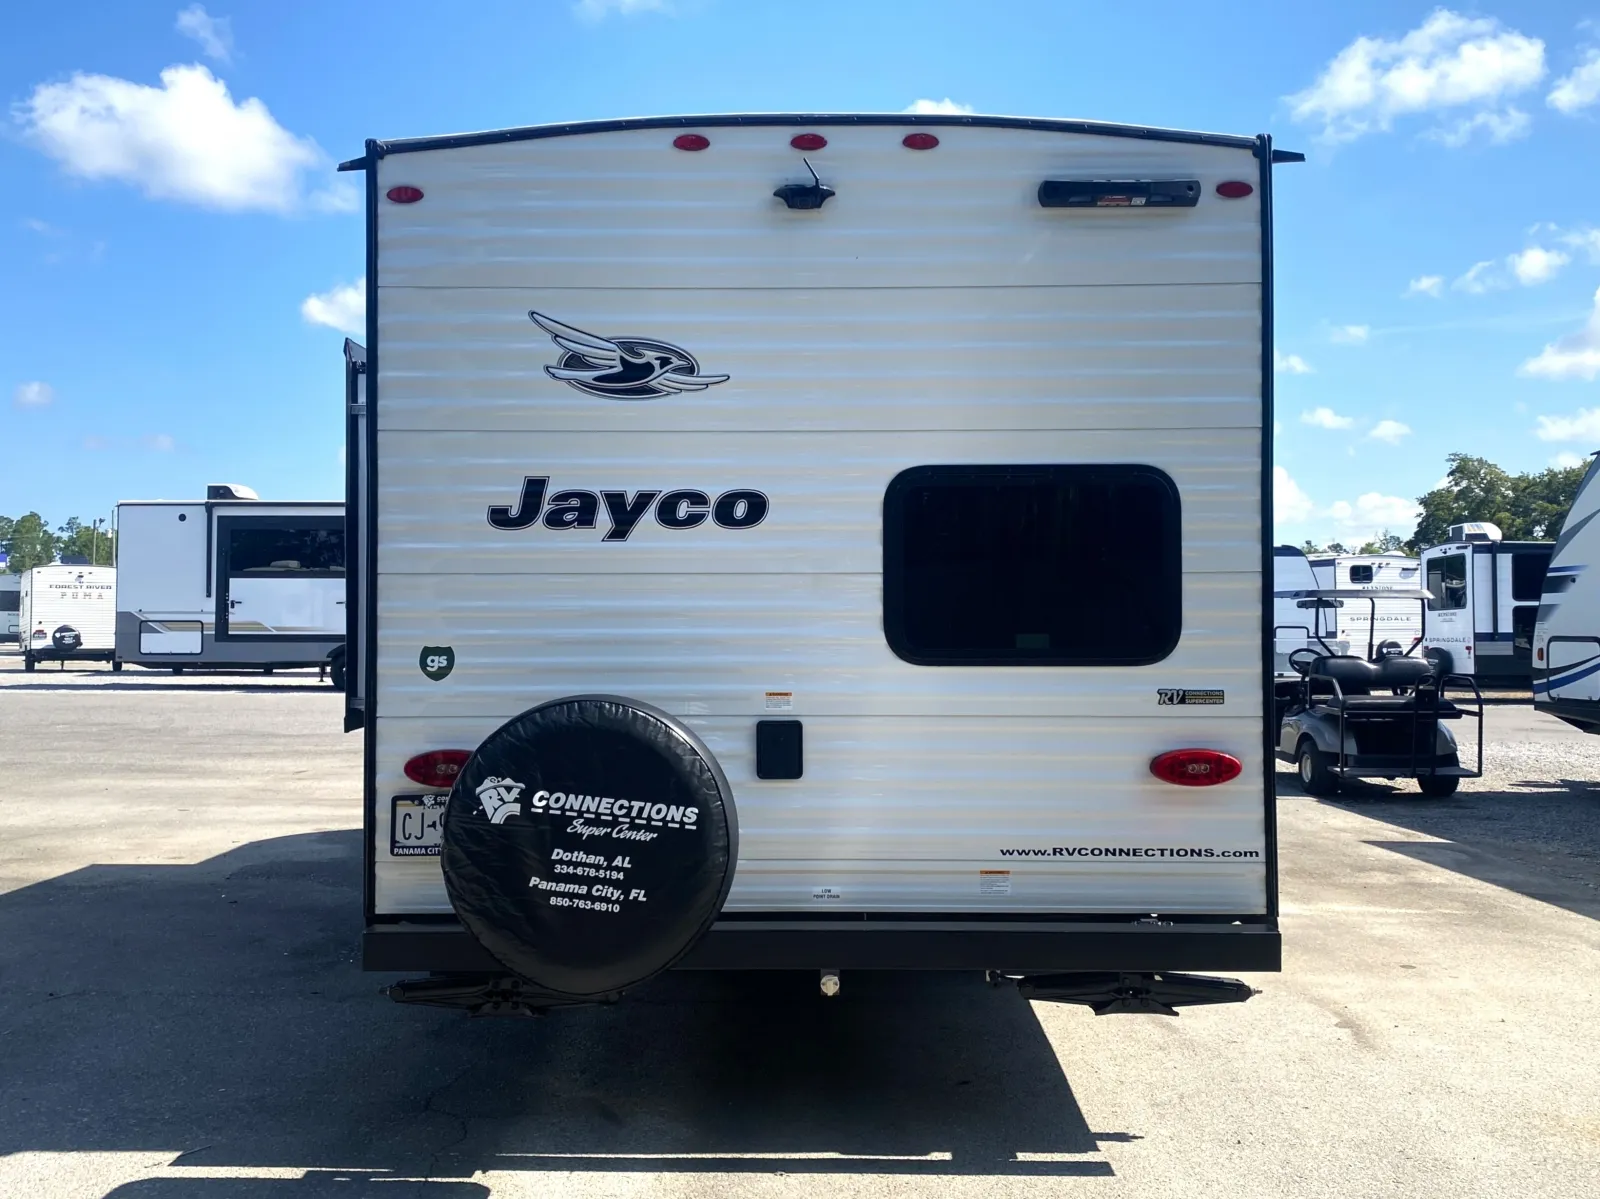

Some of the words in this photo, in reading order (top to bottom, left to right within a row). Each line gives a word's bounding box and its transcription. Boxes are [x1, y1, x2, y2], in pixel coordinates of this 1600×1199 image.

[487, 476, 770, 542] Jayco
[425, 655, 448, 672] gs
[1157, 689, 1184, 705] RV
[532, 790, 699, 824] CONNECTIONS
[566, 818, 612, 841] Super
[611, 824, 658, 842] Center
[394, 847, 426, 855] PANAMA
[551, 848, 608, 868] Dothan,
[611, 855, 632, 868] AL
[1000, 847, 1260, 859] www.RVCONNECTIONS.com
[554, 864, 625, 880] 334-678-5194
[528, 876, 588, 895] Panama
[591, 884, 625, 901] City,
[628, 889, 648, 902] FL
[549, 896, 621, 913] 850-763-6910
